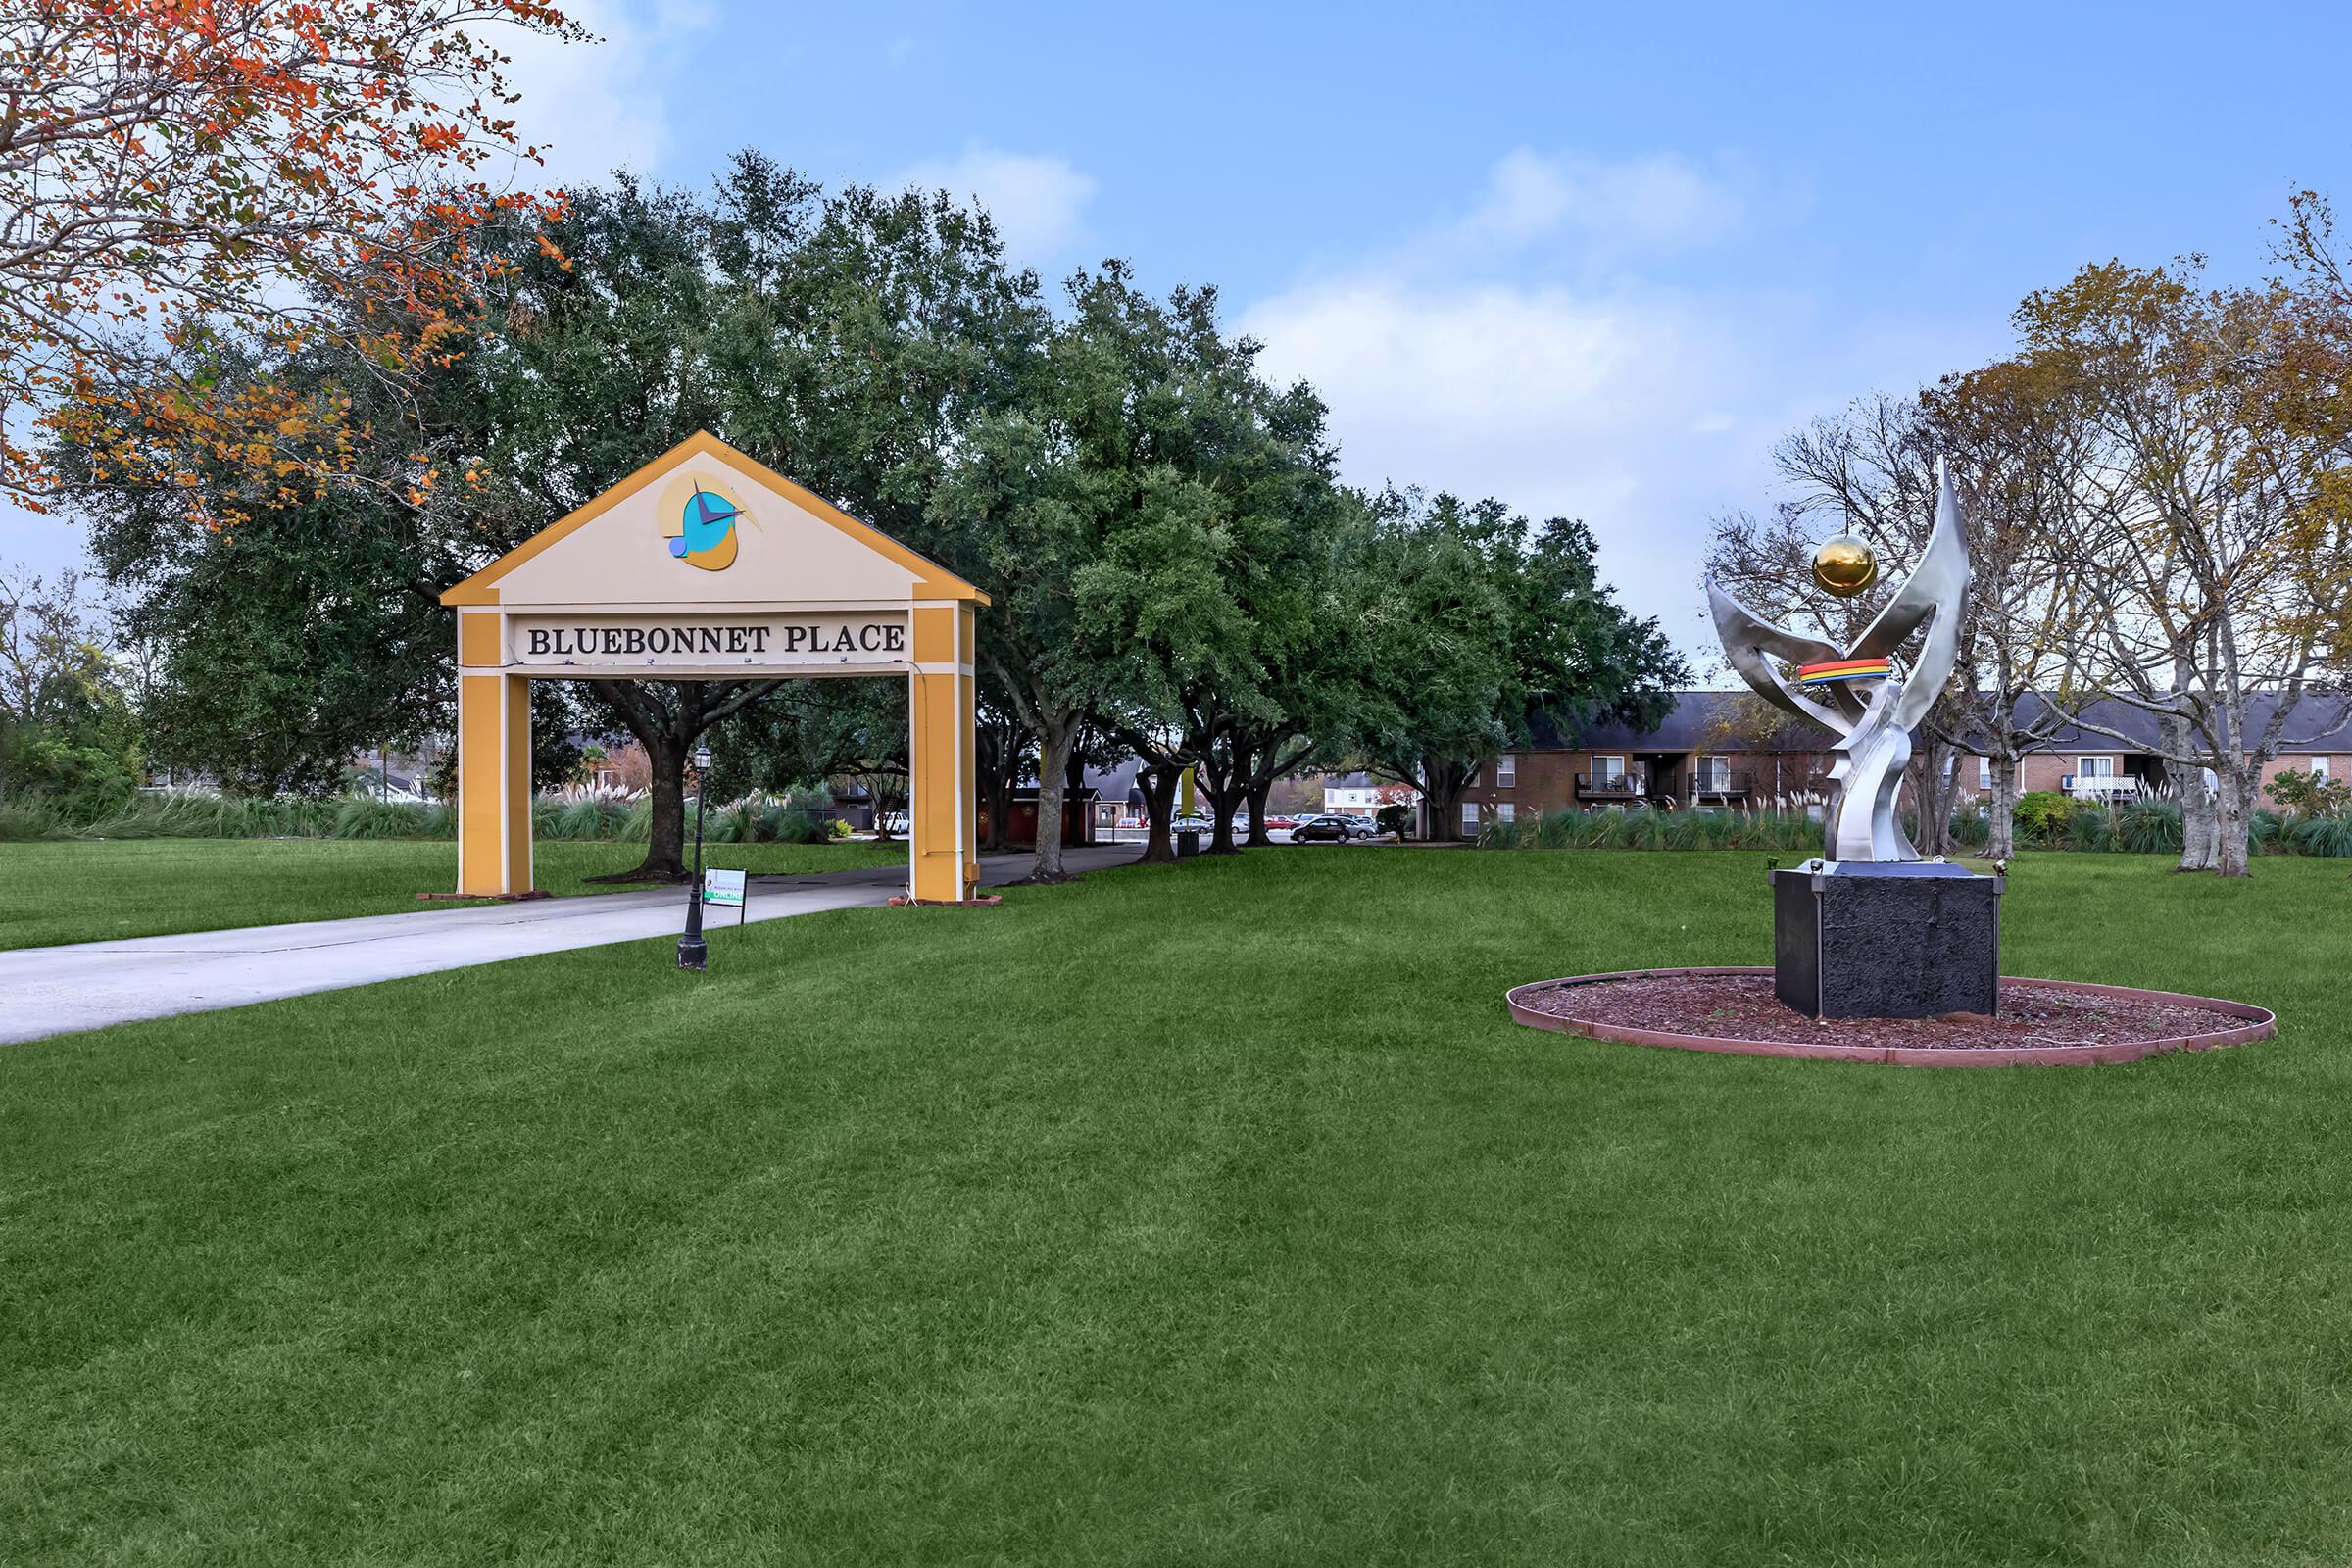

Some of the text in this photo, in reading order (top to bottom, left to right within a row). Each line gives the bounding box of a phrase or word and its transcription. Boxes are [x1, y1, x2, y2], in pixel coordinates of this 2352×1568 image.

[527, 624, 905, 655] BLUEBONNET PLACE
[714, 891, 743, 900] ONLINE
